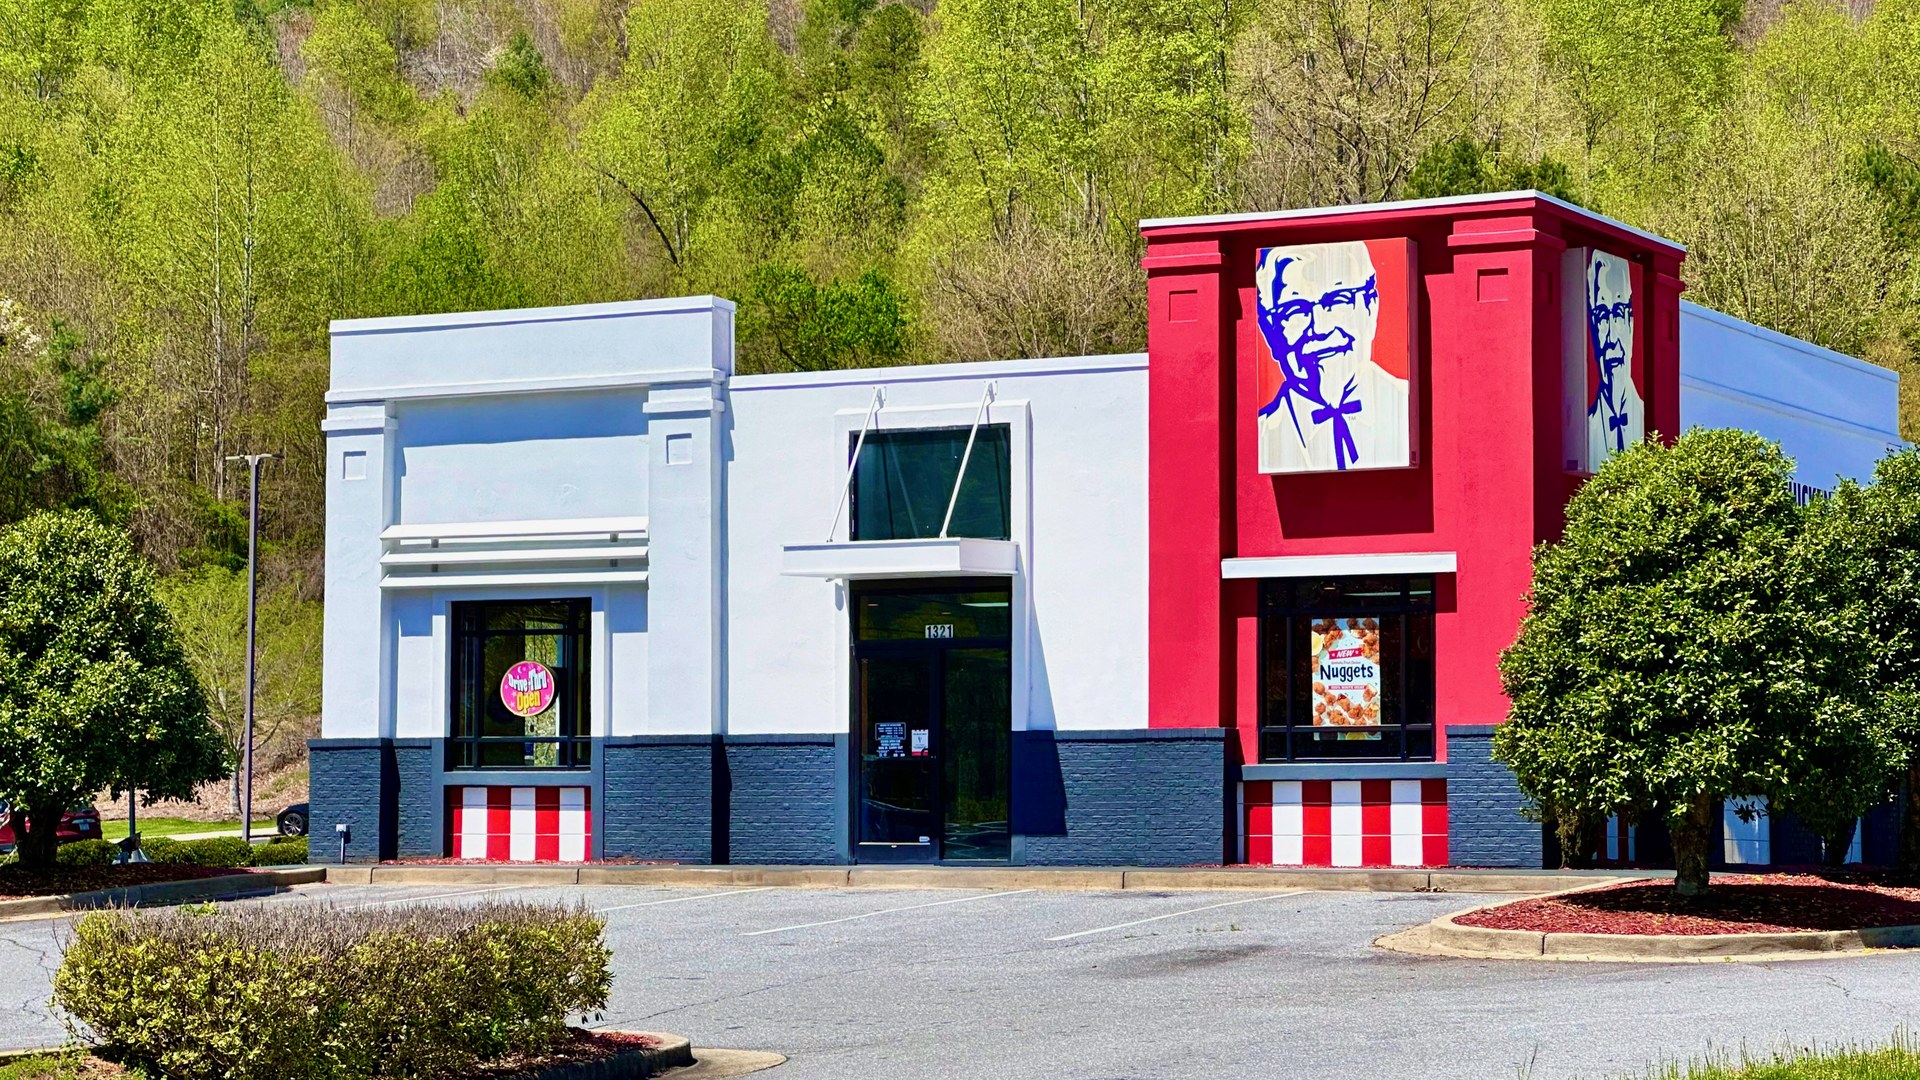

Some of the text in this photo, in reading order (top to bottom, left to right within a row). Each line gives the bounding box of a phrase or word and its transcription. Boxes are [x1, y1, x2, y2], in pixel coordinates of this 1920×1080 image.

[927, 624, 952, 638] 1321
[1337, 649, 1354, 658] NEW
[1320, 664, 1373, 682] Nuggets
[516, 690, 541, 714] Open
